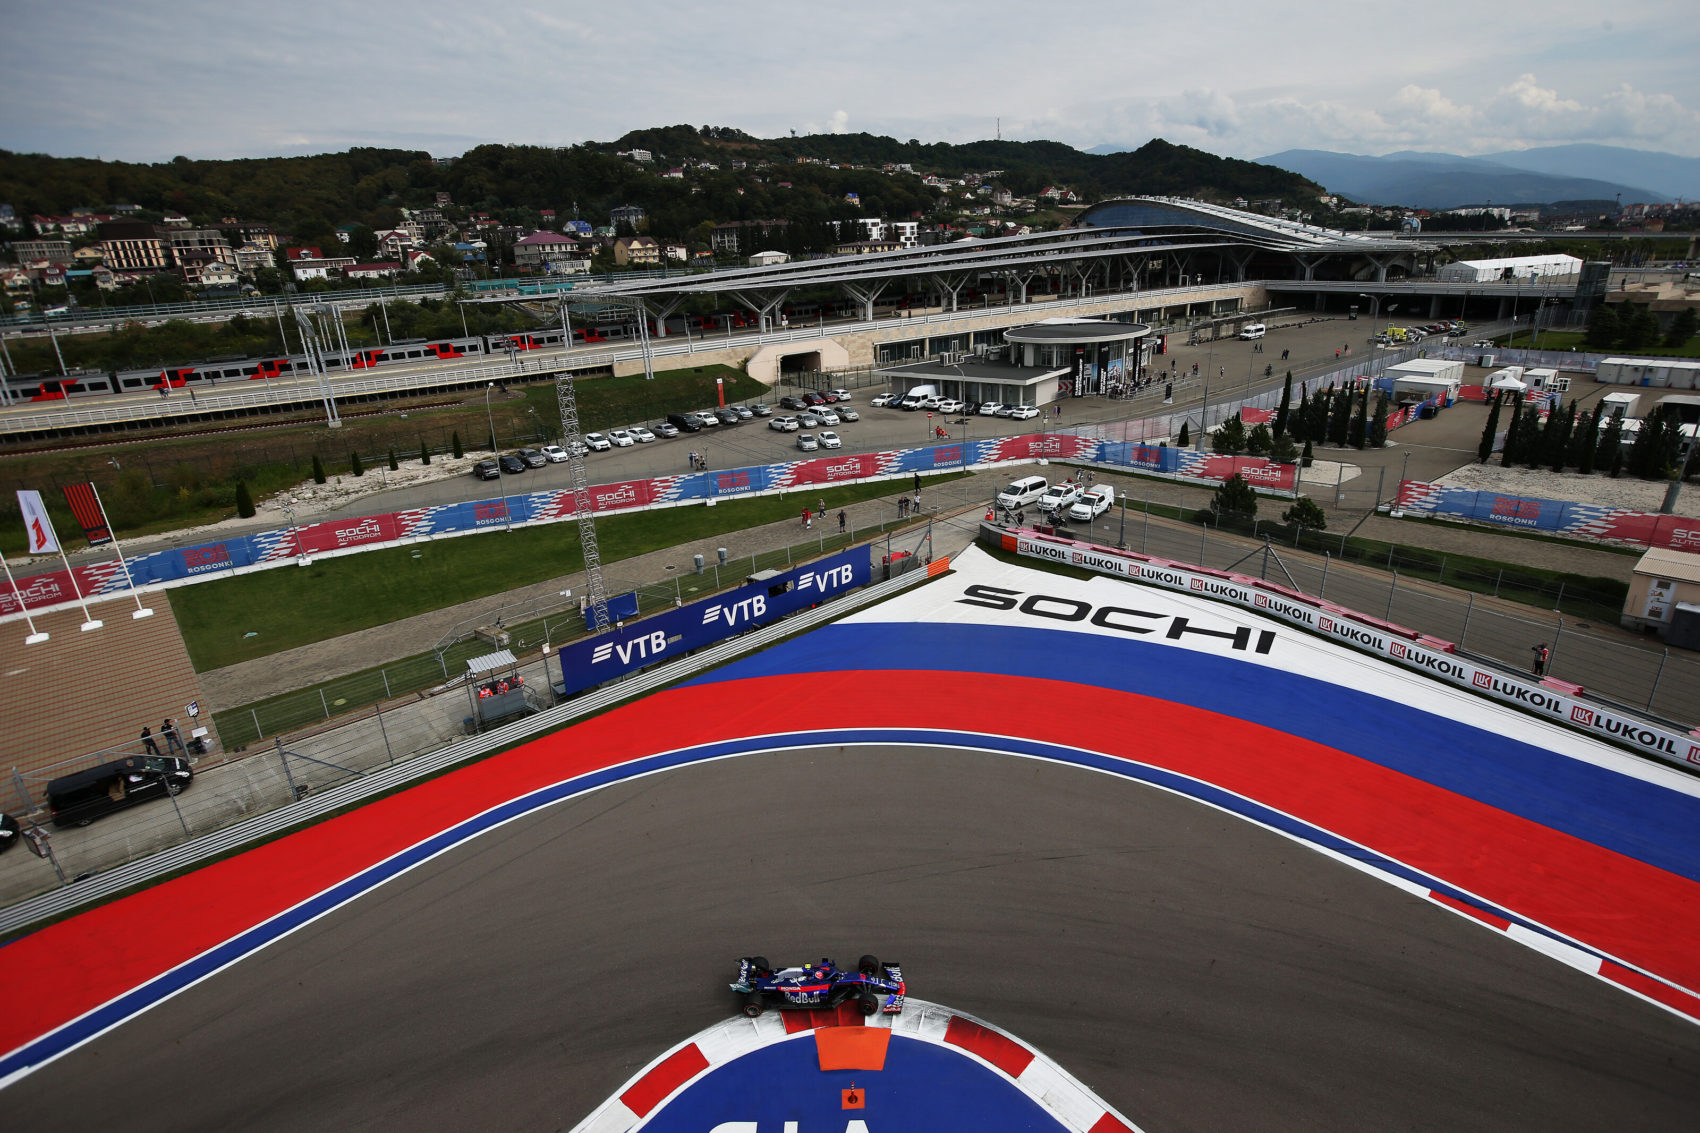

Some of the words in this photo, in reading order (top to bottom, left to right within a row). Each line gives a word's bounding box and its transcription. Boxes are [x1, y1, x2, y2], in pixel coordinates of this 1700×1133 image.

[826, 463, 860, 473] SOCHI
[1241, 466, 1281, 477] SOCHI
[1241, 473, 1280, 481] AUTODROM
[596, 490, 635, 502] SOCHI
[598, 498, 636, 507] AUTODROM
[1489, 513, 1538, 526] ROSGONKI
[335, 524, 380, 538] SOCHI
[337, 532, 381, 543] AUTODROM
[1030, 544, 1067, 560] LUKOIL
[187, 560, 233, 573] ROSGONKI
[1083, 555, 1124, 573] LUKOIL
[816, 564, 853, 593] VTB
[1140, 568, 1184, 586] LUKOIL
[0, 583, 60, 604] SOCHI
[1204, 581, 1249, 602] LUKOIL
[723, 595, 767, 626] VTB
[954, 584, 1276, 655] SOCHI
[1267, 599, 1313, 624] LUKOIL
[1333, 623, 1384, 651] LUKOIL
[615, 630, 667, 665] VTB
[1406, 649, 1466, 680] LUKOIL
[1492, 679, 1563, 714] LUKOIL
[1594, 715, 1677, 755] LUKOIL
